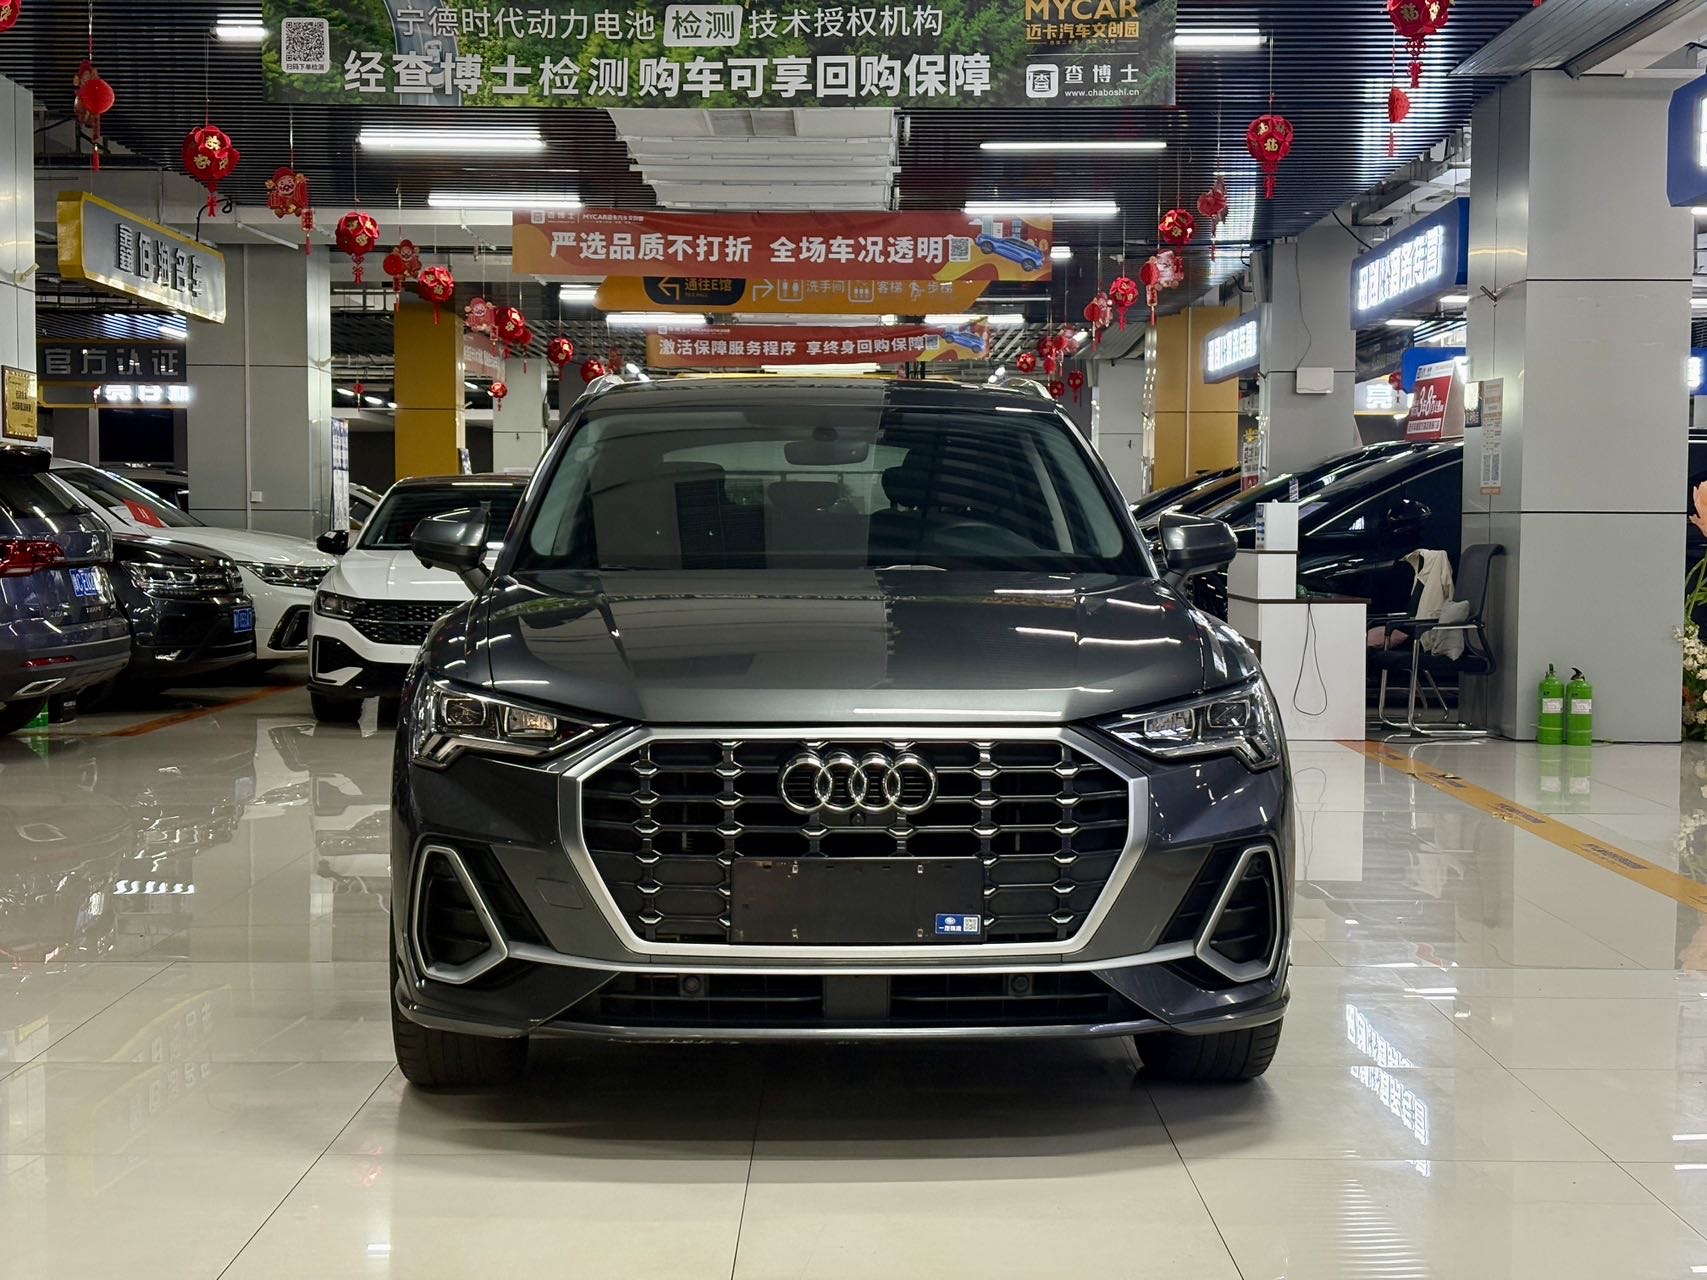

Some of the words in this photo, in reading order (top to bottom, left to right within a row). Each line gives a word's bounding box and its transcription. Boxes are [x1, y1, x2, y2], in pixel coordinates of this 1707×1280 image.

[1025, 0, 1139, 20] MYCAR
[396, 8, 656, 41] 宁德时代动力电池
[671, 10, 736, 40] 检测
[748, 4, 944, 39] 技术授权机构
[1026, 21, 1140, 41] 迈卡汽车文创园
[286, 63, 325, 71] 扫码下单检测
[343, 48, 993, 98] 经查博士检测购车可享回购保障
[1064, 63, 1140, 84] 查博士
[1064, 88, 1141, 98] www.chaboshi.cn
[551, 231, 752, 262] 严选品质不打折
[769, 236, 943, 264] 全场车况透明
[806, 280, 845, 293] 洗手间
[659, 339, 796, 356] 激活保障服务程序
[806, 336, 926, 356] 享终身回购保障
[45, 348, 179, 376] 官方认证
